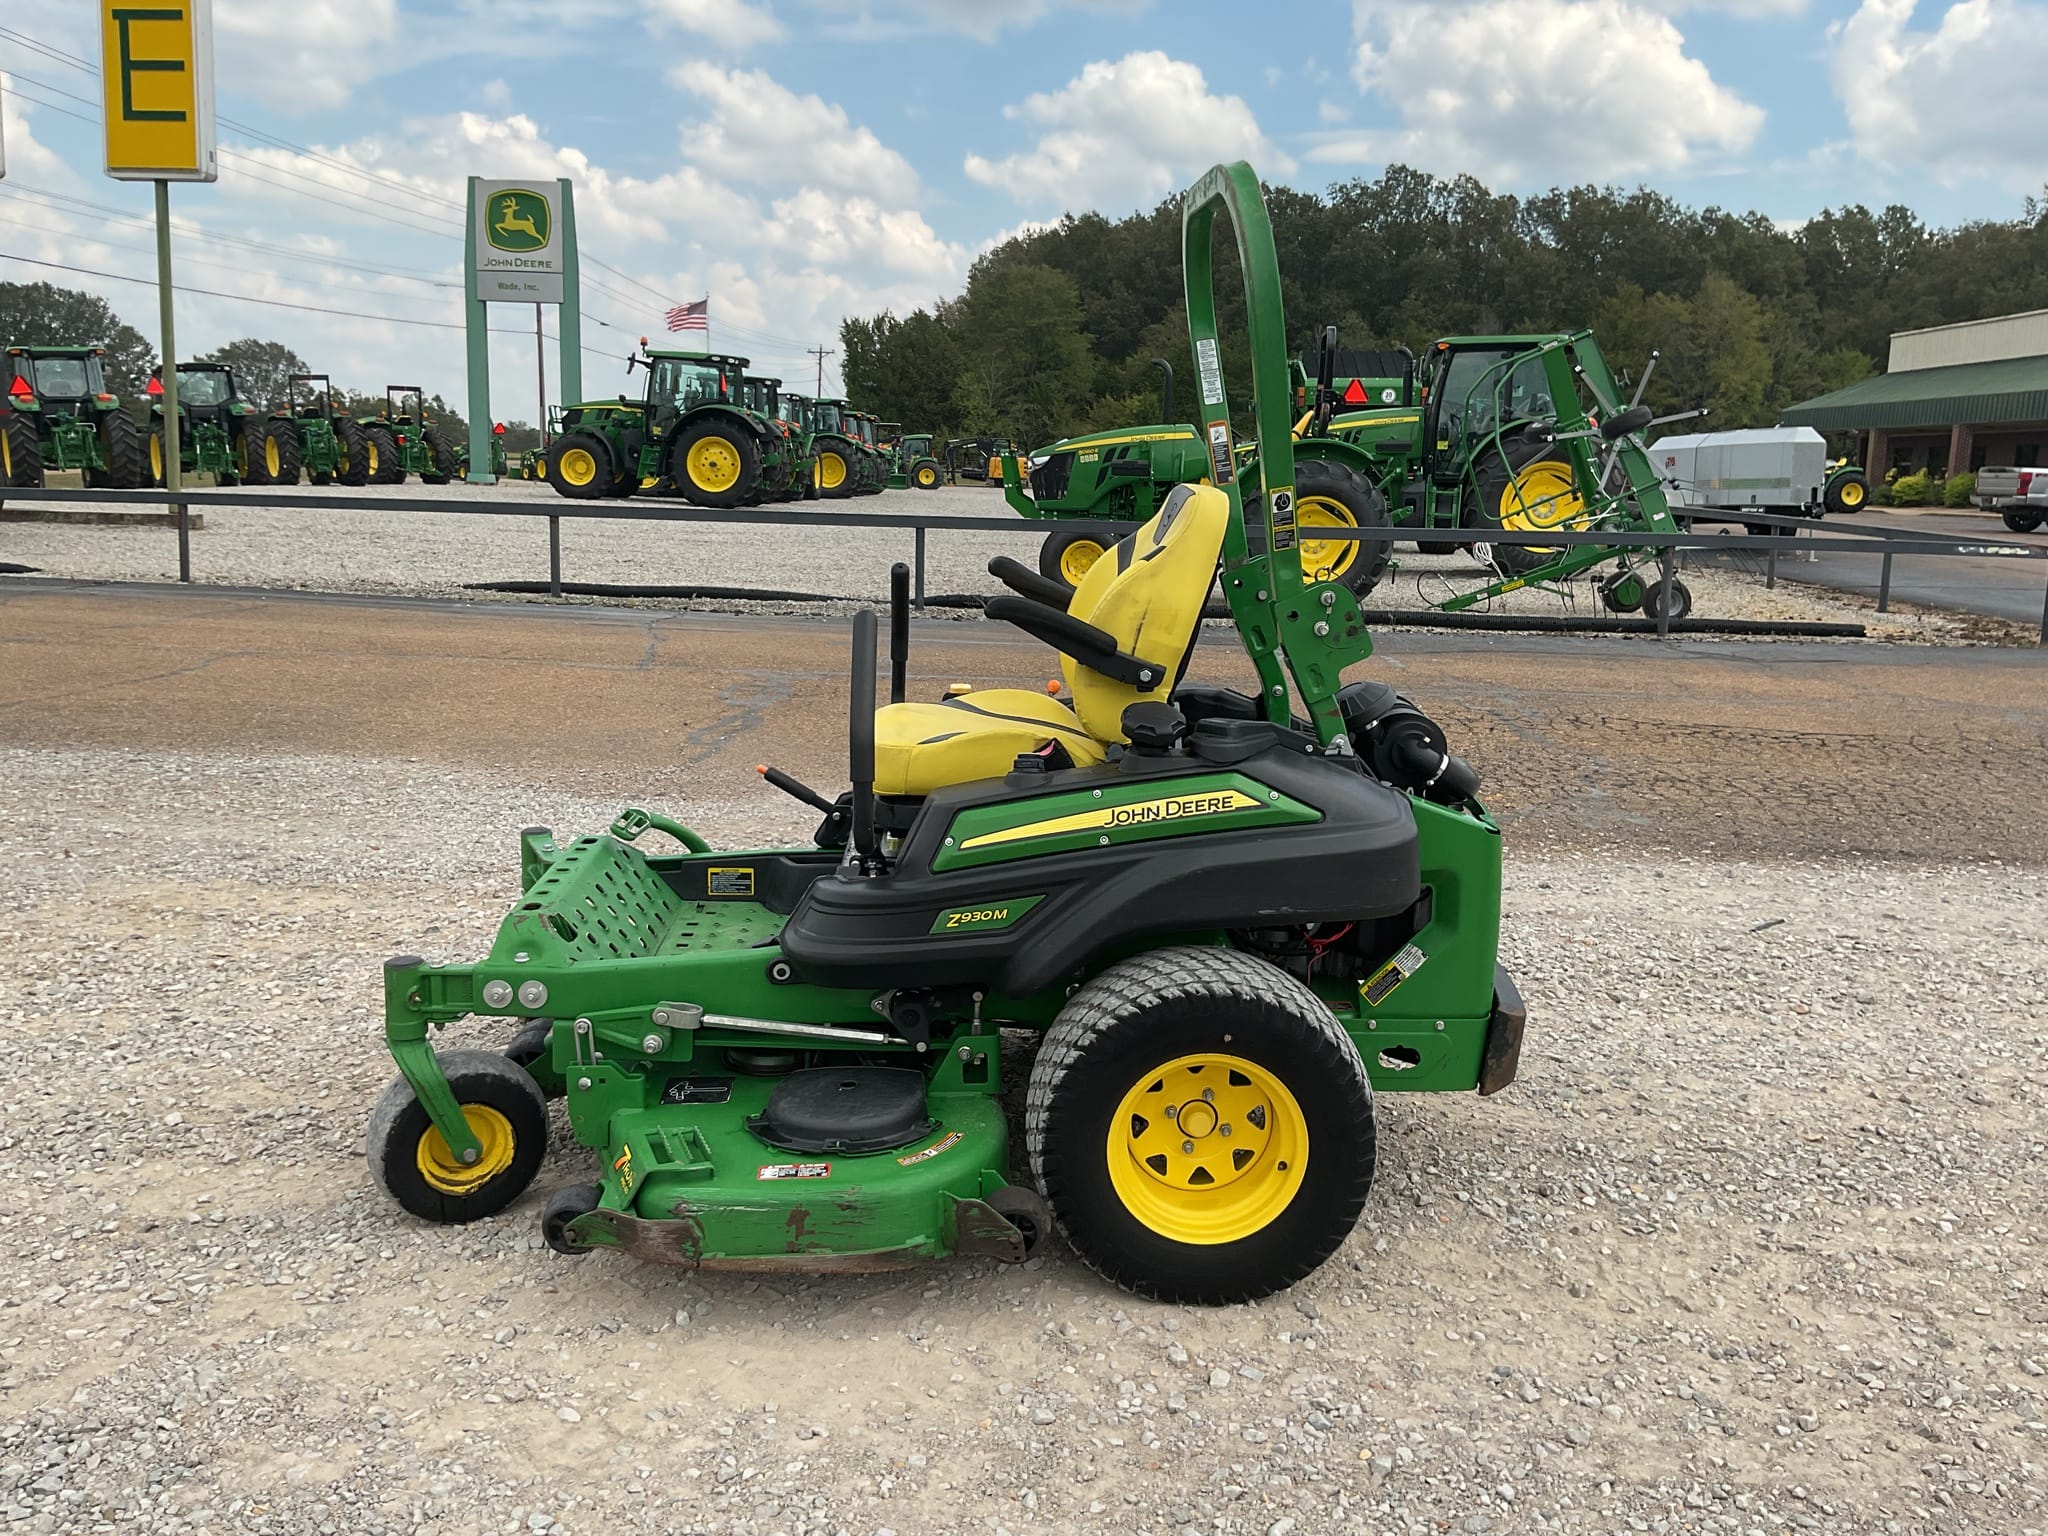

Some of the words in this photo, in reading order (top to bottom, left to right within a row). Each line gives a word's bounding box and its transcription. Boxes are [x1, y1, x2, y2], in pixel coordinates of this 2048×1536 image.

[111, 9, 187, 122] E
[483, 257, 513, 267] JOHN
[514, 257, 553, 269] DEERE
[497, 281, 522, 292] Wade,
[523, 282, 540, 291] Inc.
[1103, 805, 1160, 826] JOHN
[1165, 796, 1234, 817] DEERE
[946, 908, 1009, 928] Z930M
